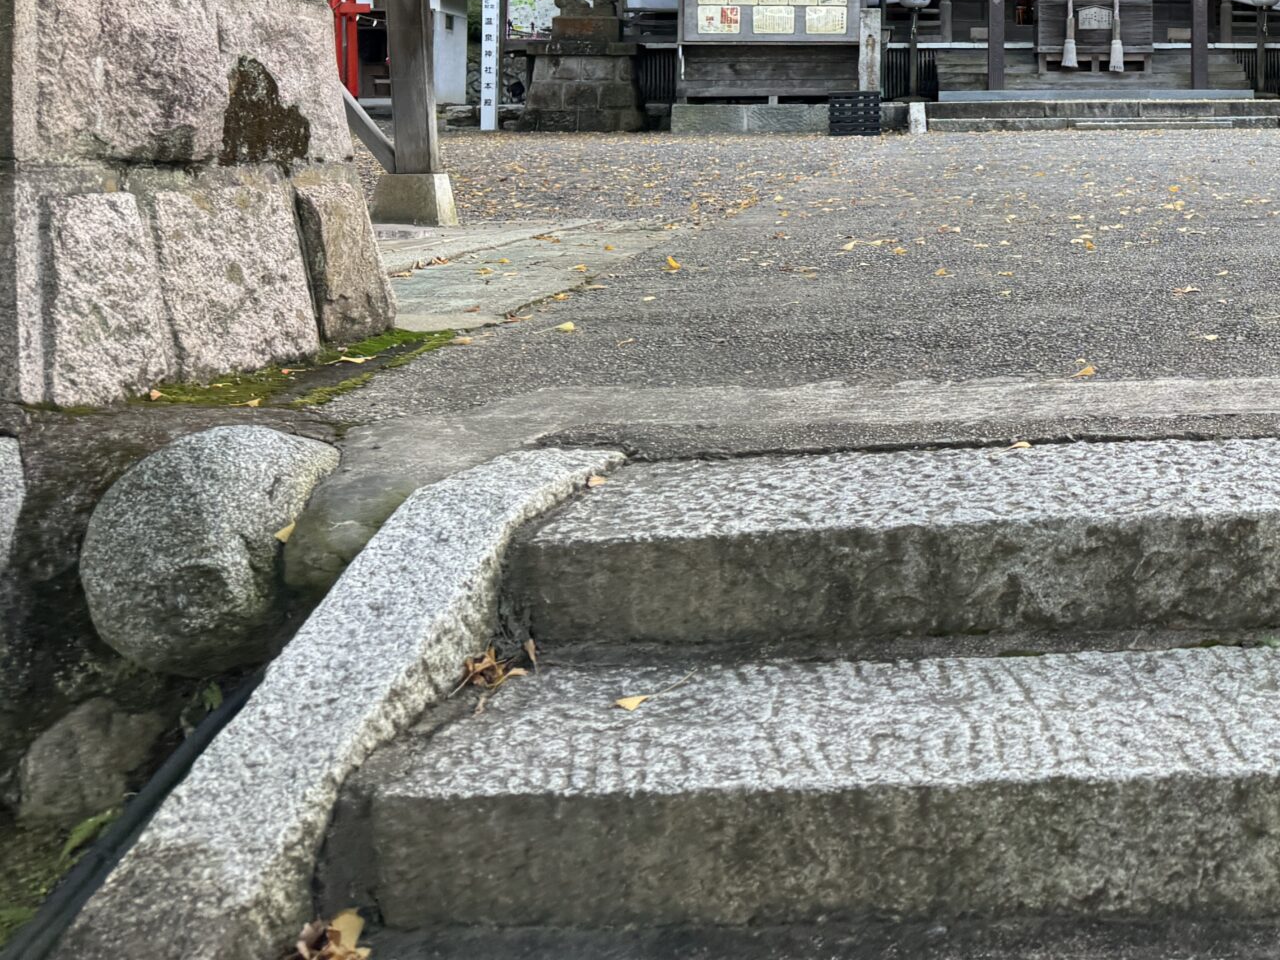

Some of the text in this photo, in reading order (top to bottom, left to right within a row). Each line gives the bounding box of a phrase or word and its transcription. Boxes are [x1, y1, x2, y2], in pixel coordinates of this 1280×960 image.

[483, 17, 493, 107] 温泉神社本殿
